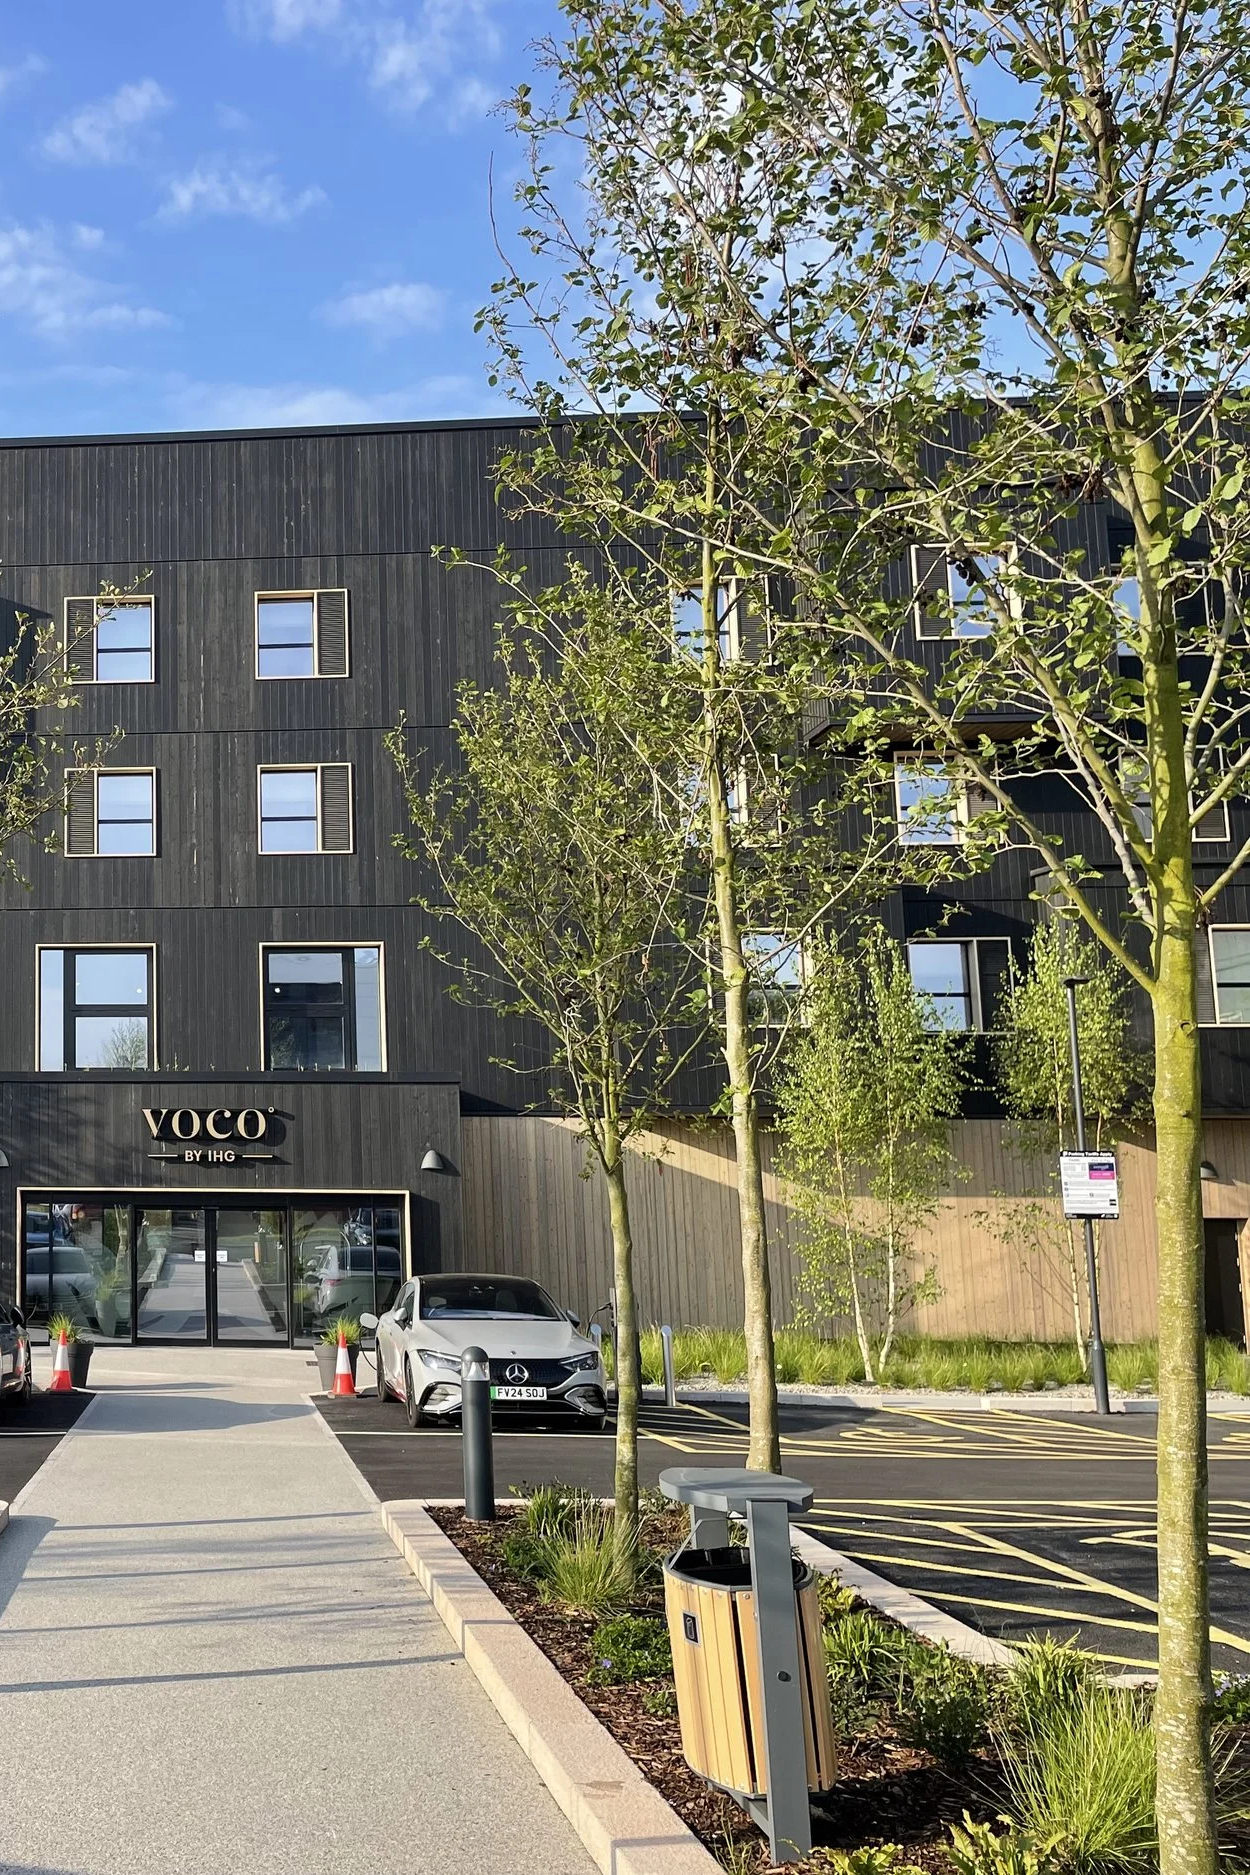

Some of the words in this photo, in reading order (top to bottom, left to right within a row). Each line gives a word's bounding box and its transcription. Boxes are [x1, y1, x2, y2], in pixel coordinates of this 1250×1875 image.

[184, 1150, 203, 1162] BY
[208, 1150, 235, 1162] IHG
[497, 1388, 523, 1398] FV24
[525, 1388, 545, 1398] SOJ
